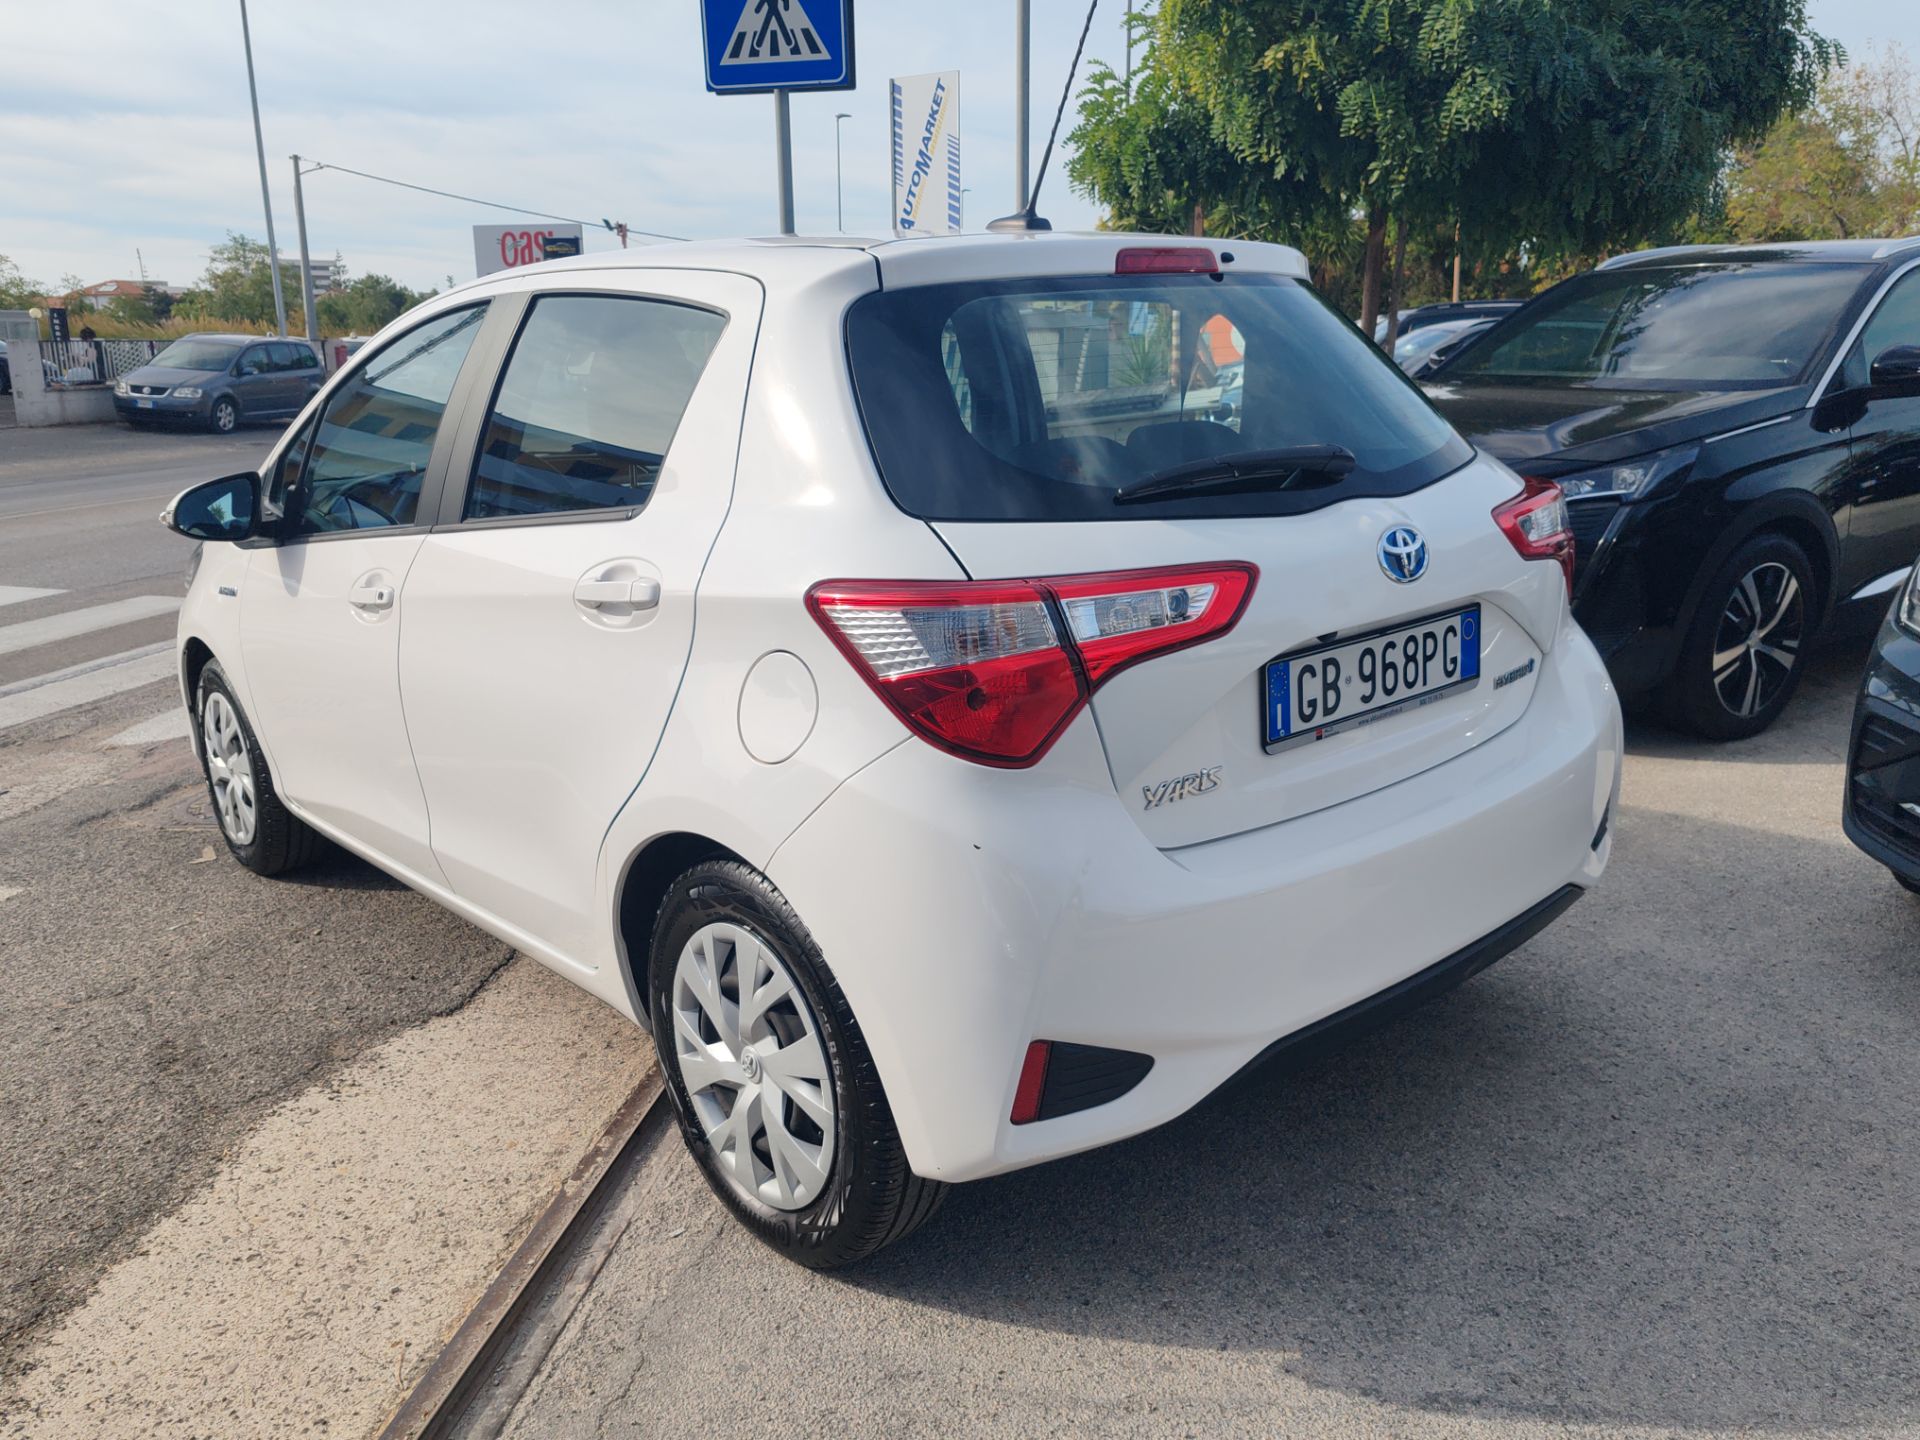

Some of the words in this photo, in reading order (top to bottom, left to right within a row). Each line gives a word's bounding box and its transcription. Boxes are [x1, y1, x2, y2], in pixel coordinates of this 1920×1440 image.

[899, 77, 946, 230] AUTOMARKET
[1297, 656, 1342, 724] GB
[1357, 624, 1458, 705] 968PG
[1142, 765, 1223, 811] YARIS
